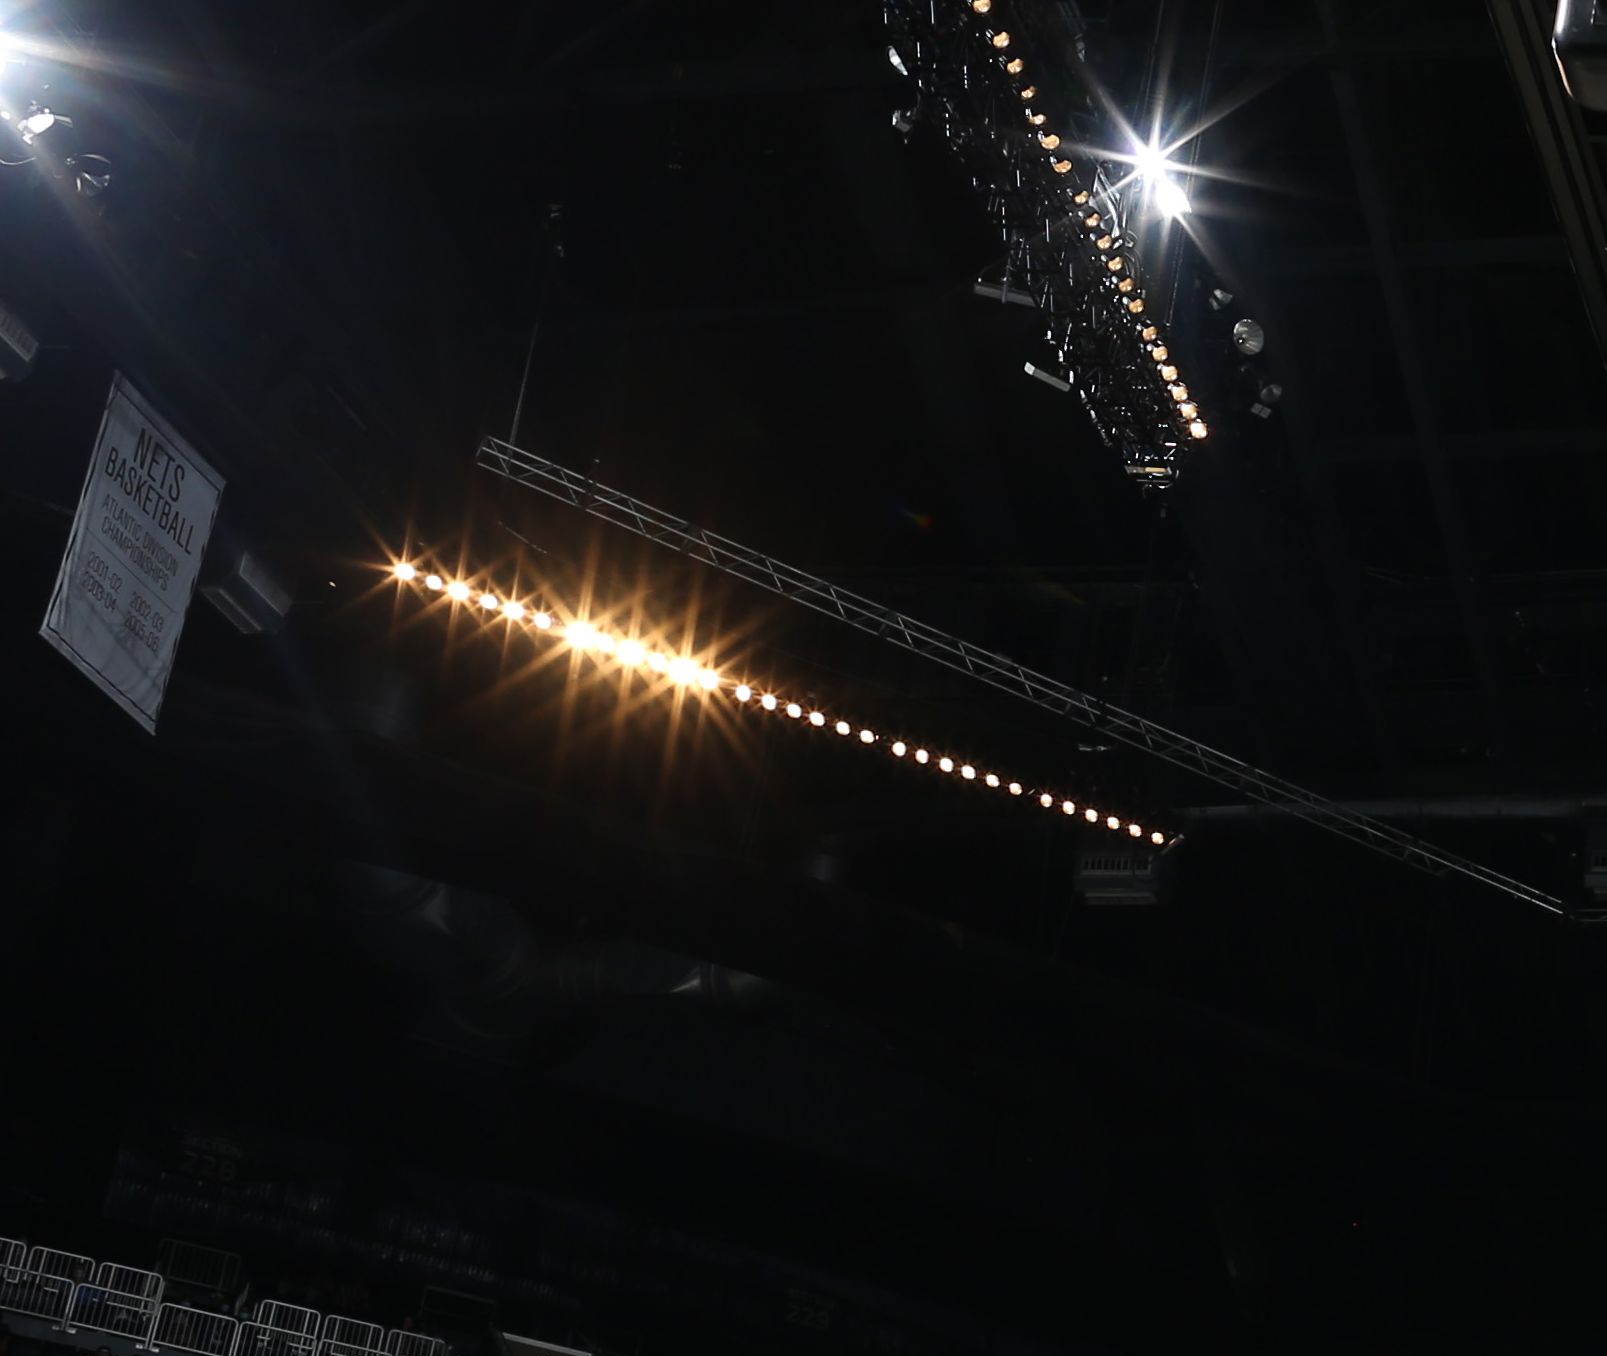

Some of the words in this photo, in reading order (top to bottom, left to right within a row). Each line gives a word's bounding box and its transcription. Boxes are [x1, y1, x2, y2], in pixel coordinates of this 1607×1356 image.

[105, 446, 194, 555] BASKETBALL
[133, 427, 185, 501] NETS
[102, 493, 141, 543] ATLANTIC
